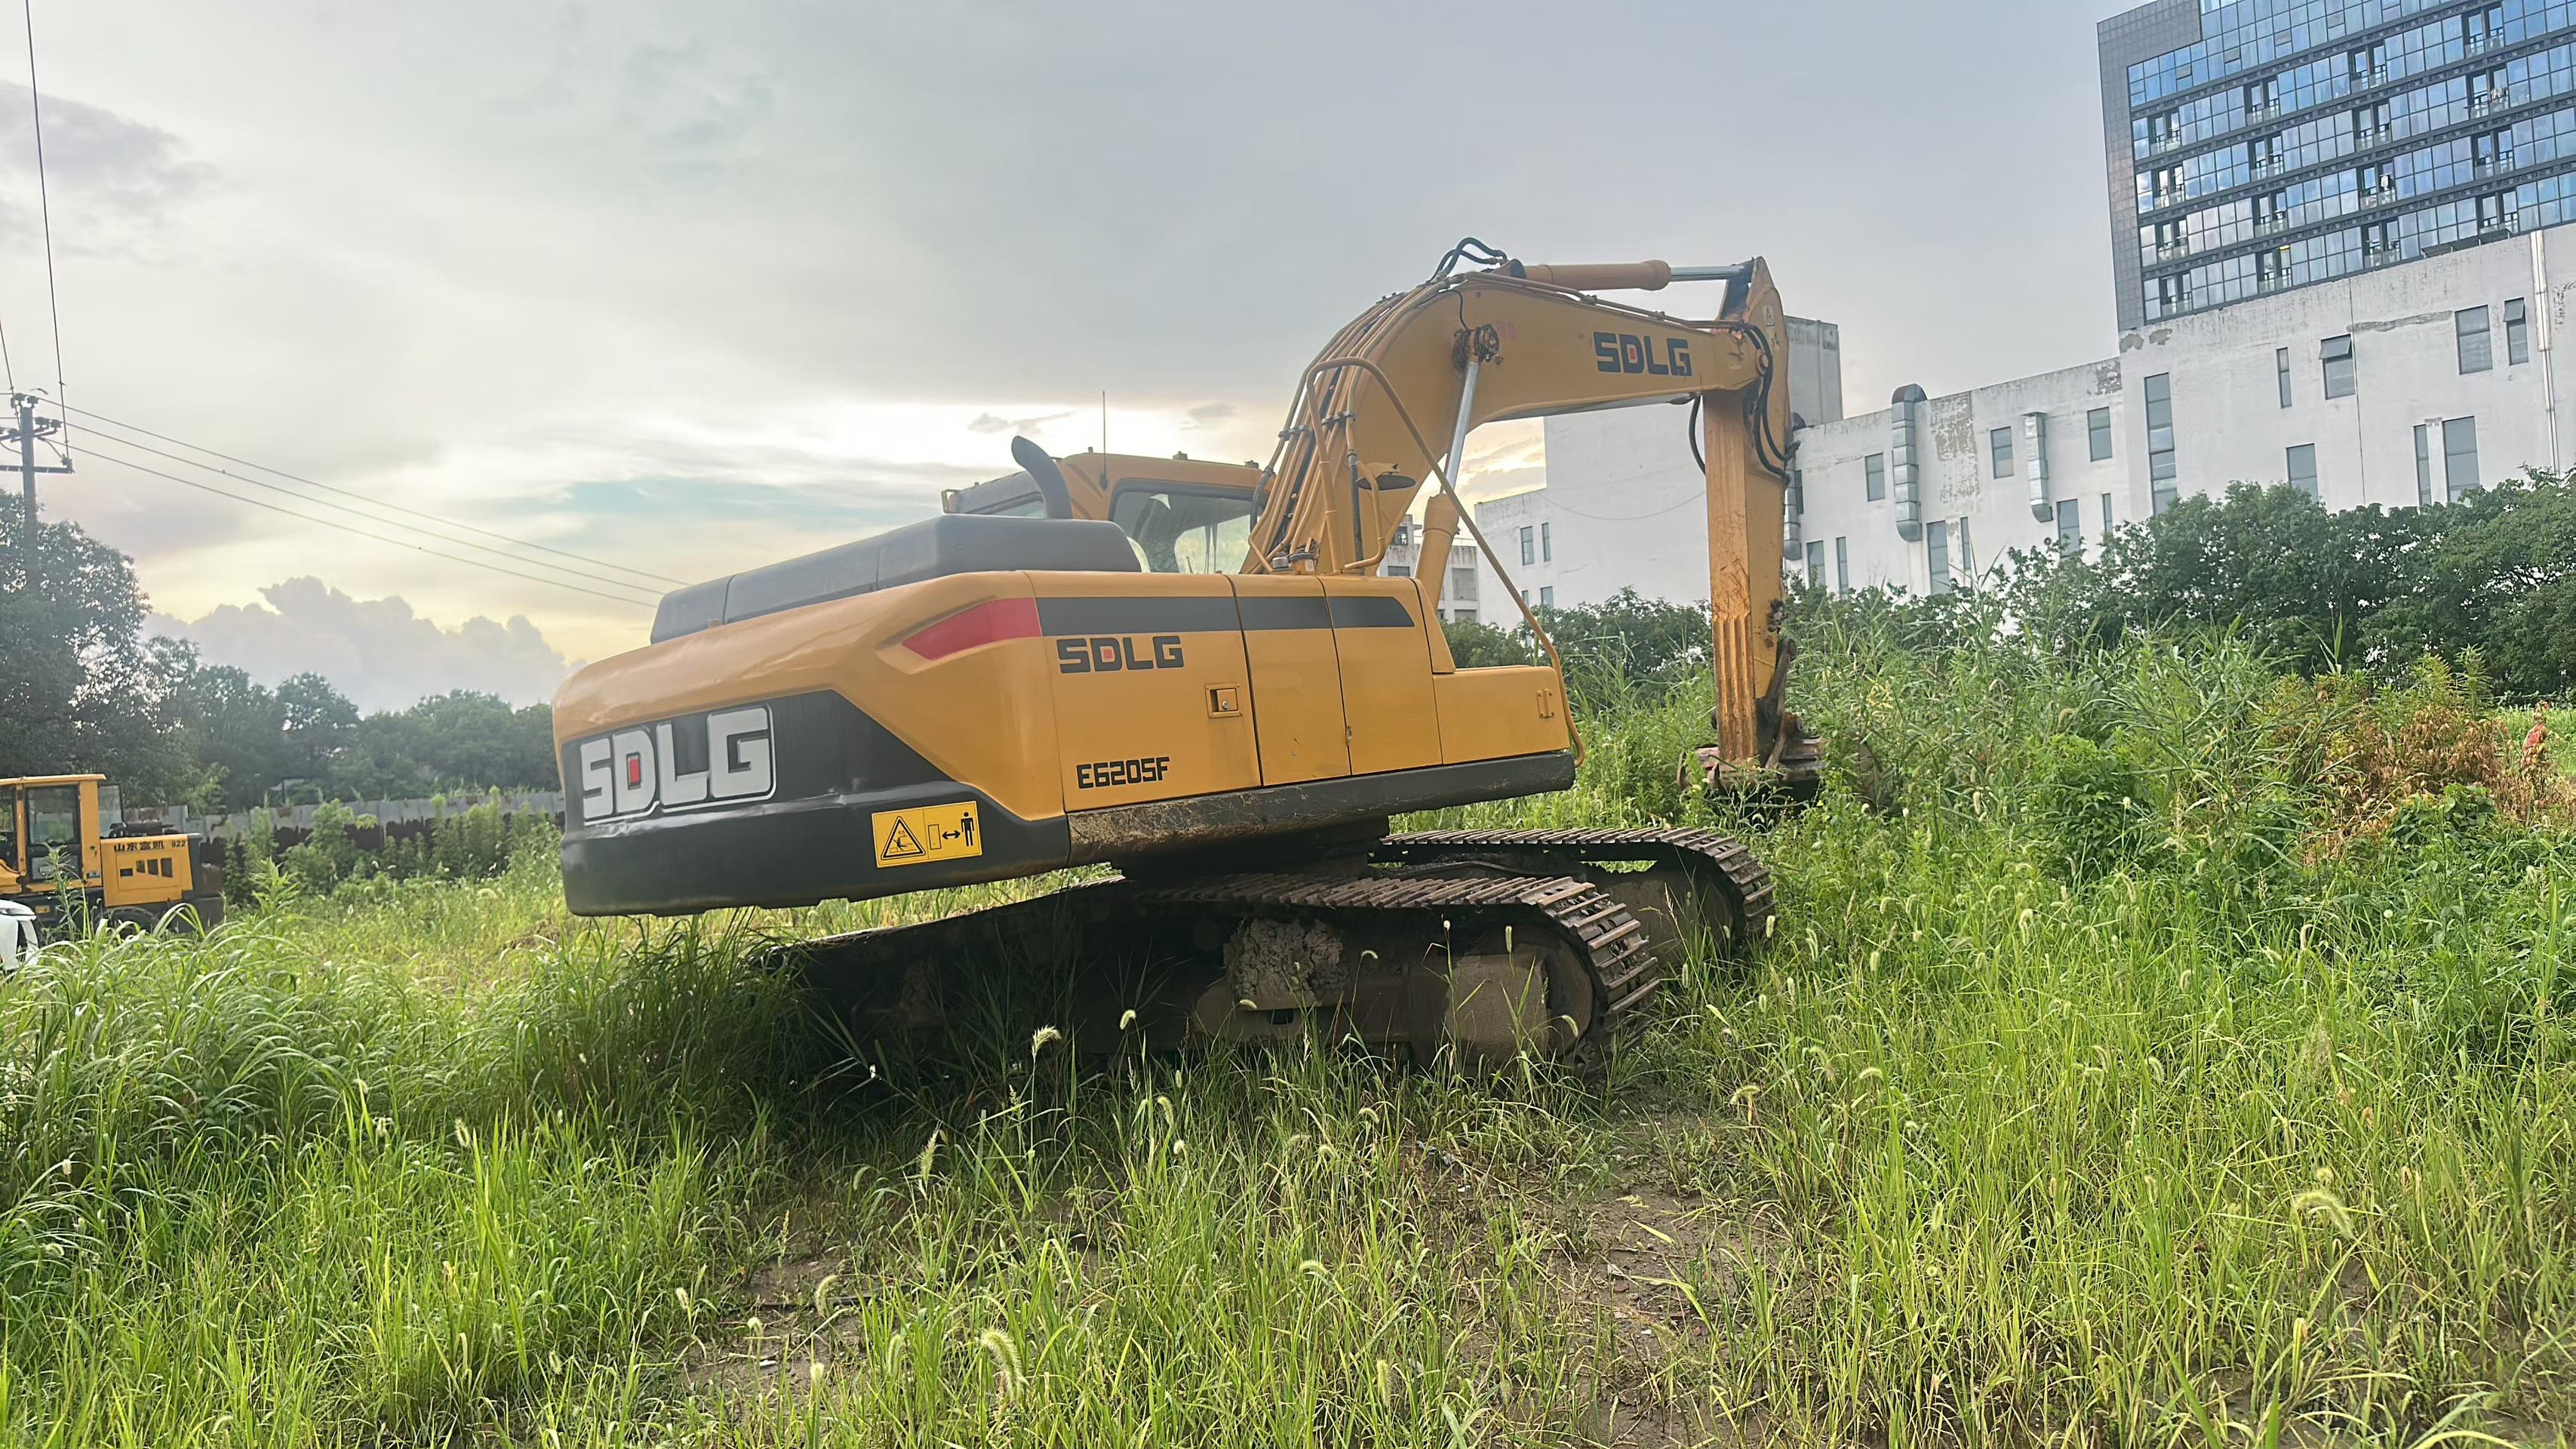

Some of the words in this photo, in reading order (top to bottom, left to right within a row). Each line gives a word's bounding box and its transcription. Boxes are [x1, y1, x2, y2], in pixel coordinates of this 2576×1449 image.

[1593, 332, 1692, 376] SDLG
[1056, 635, 1184, 673] SDLG
[579, 705, 776, 825] SDLG
[1076, 756, 1170, 789] E6205F
